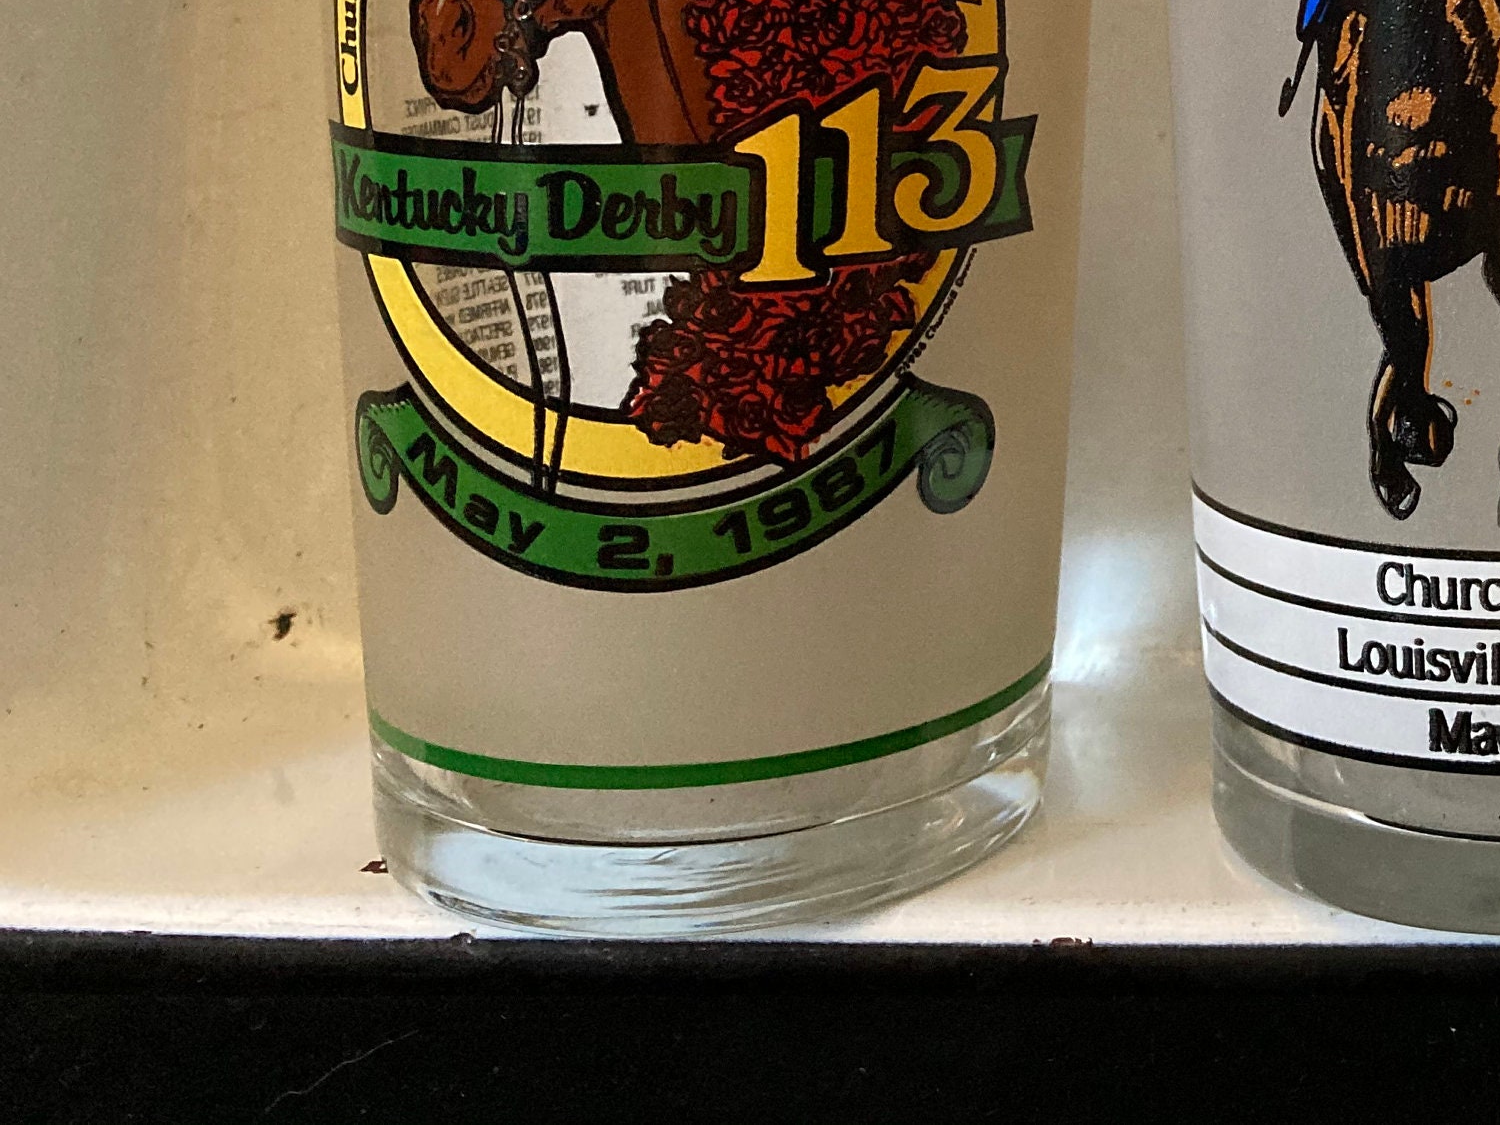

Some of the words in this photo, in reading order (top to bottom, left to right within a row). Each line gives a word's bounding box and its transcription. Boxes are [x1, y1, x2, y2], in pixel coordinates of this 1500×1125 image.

[336, 152, 529, 256] Kentucky
[536, 167, 739, 264] Derby
[733, 65, 1001, 285] 113
[955, 247, 977, 287] Downs
[405, 431, 546, 559] May
[597, 524, 676, 577] 2,
[712, 419, 898, 555] 1987
